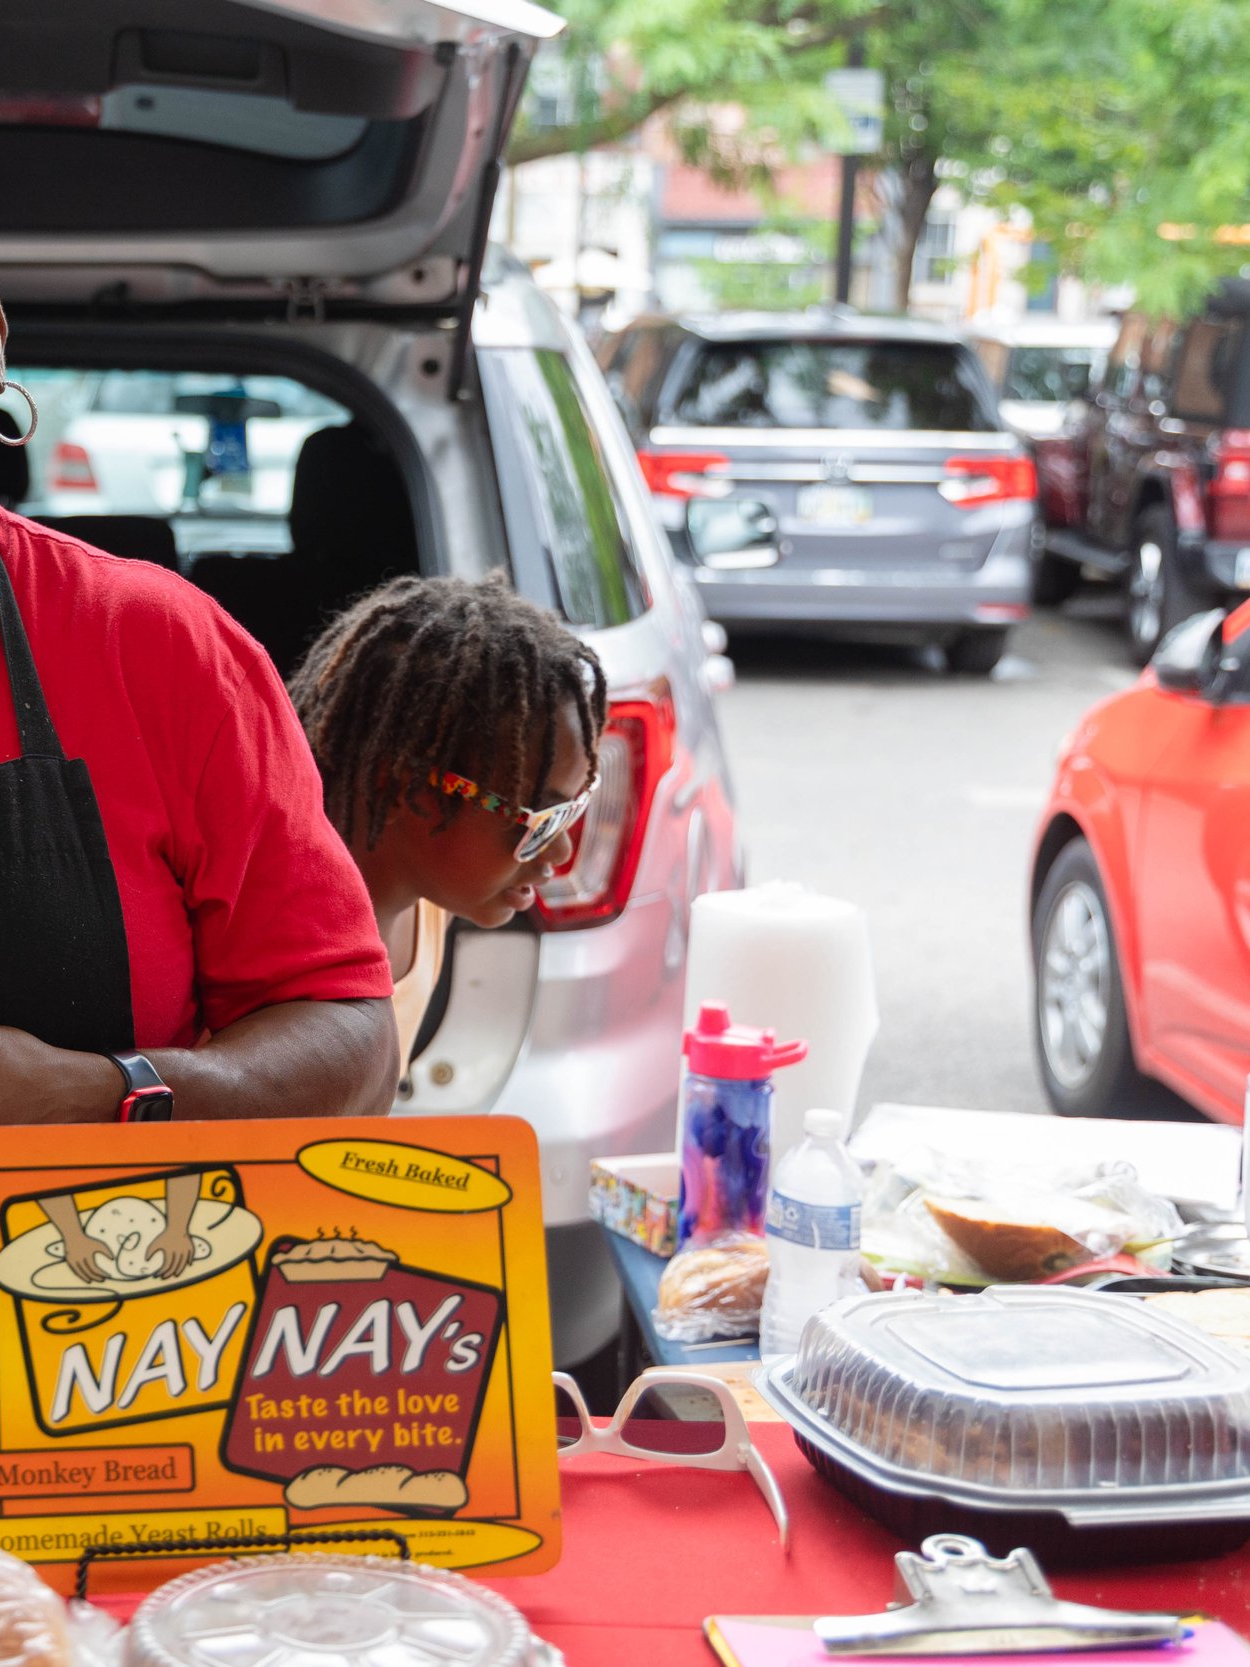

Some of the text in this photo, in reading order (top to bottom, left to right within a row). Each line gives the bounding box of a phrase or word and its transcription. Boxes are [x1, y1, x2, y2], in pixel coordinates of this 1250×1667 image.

[340, 1151, 470, 1190] Fresh Baked
[250, 1293, 484, 1379] NAY's
[51, 1300, 248, 1424] NAY
[246, 1387, 460, 1420] Taste the love
[254, 1422, 462, 1453] in every bite.
[103, 1456, 178, 1482] Bread
[129, 1523, 196, 1545] Yeast
[205, 1518, 267, 1541] Rolls
